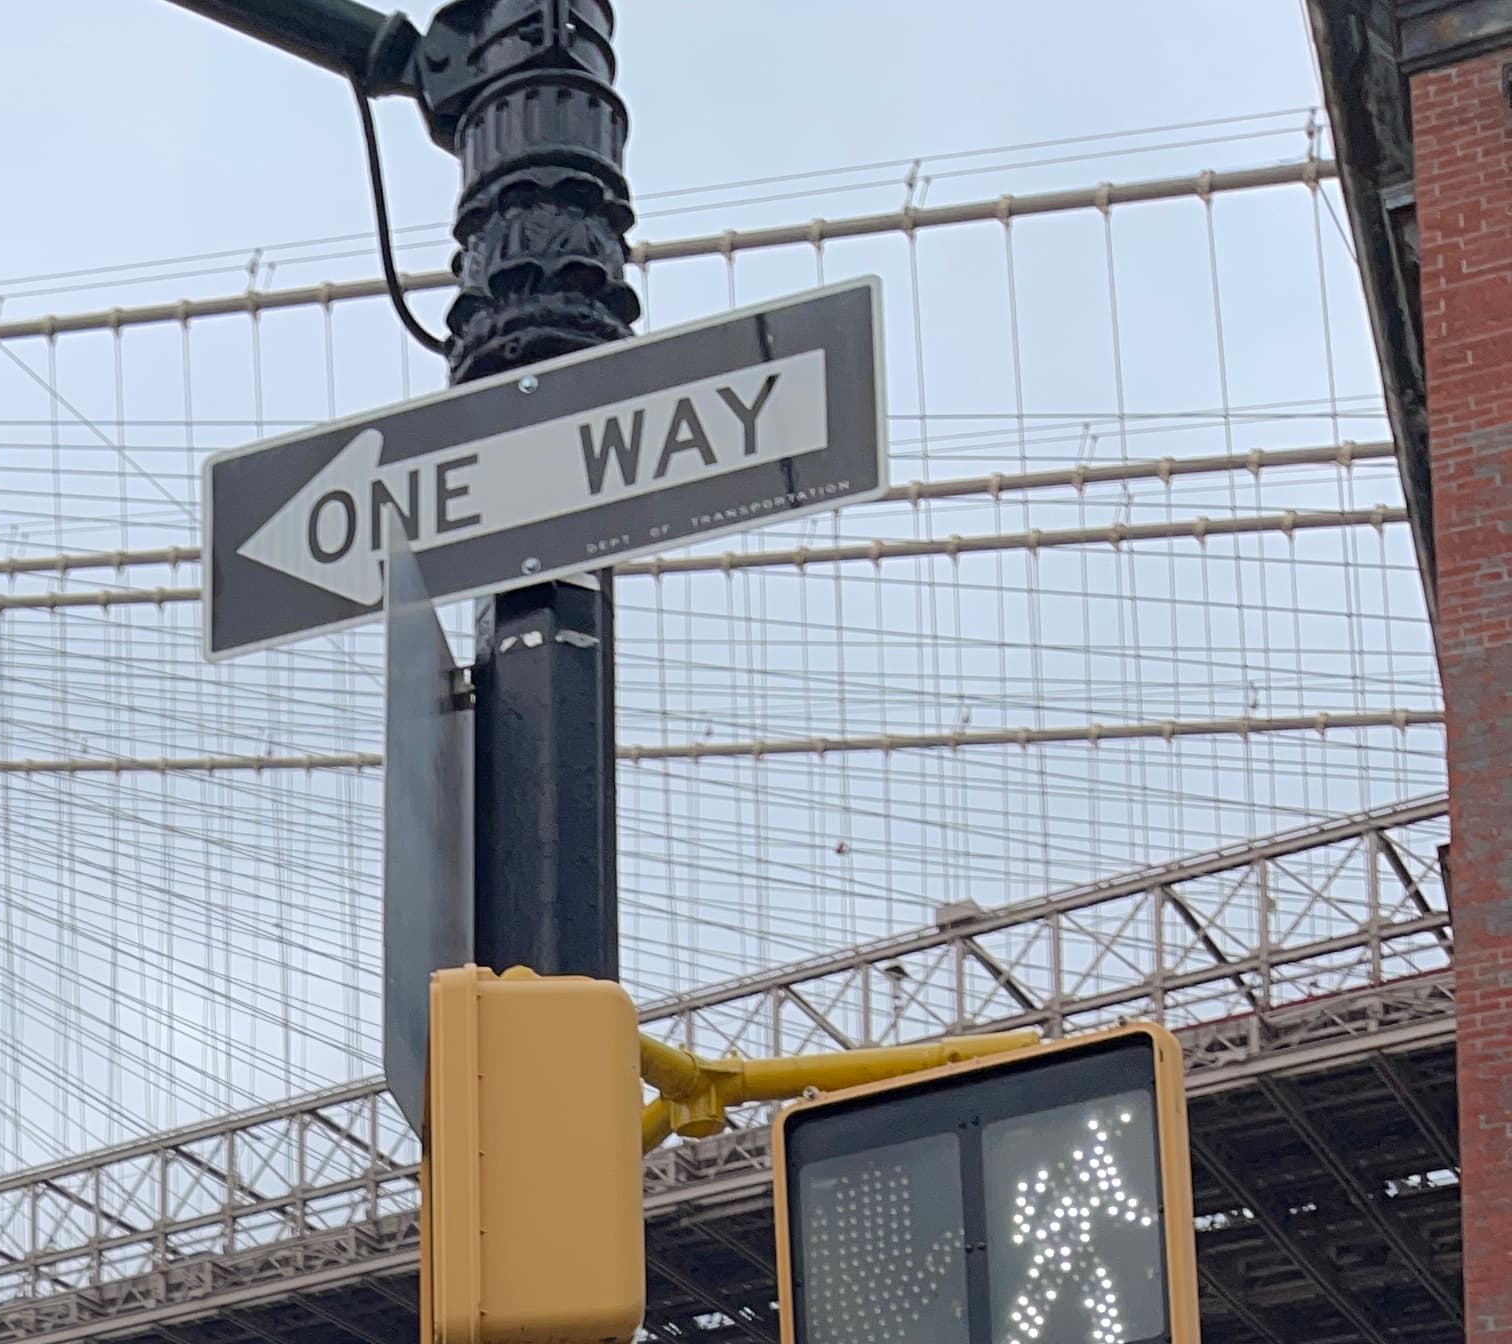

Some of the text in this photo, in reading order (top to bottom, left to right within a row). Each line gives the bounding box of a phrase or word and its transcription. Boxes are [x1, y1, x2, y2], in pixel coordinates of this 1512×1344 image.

[307, 374, 781, 564] ONE WAY
[586, 479, 851, 554] DEPT OF TRANSPORTATION
